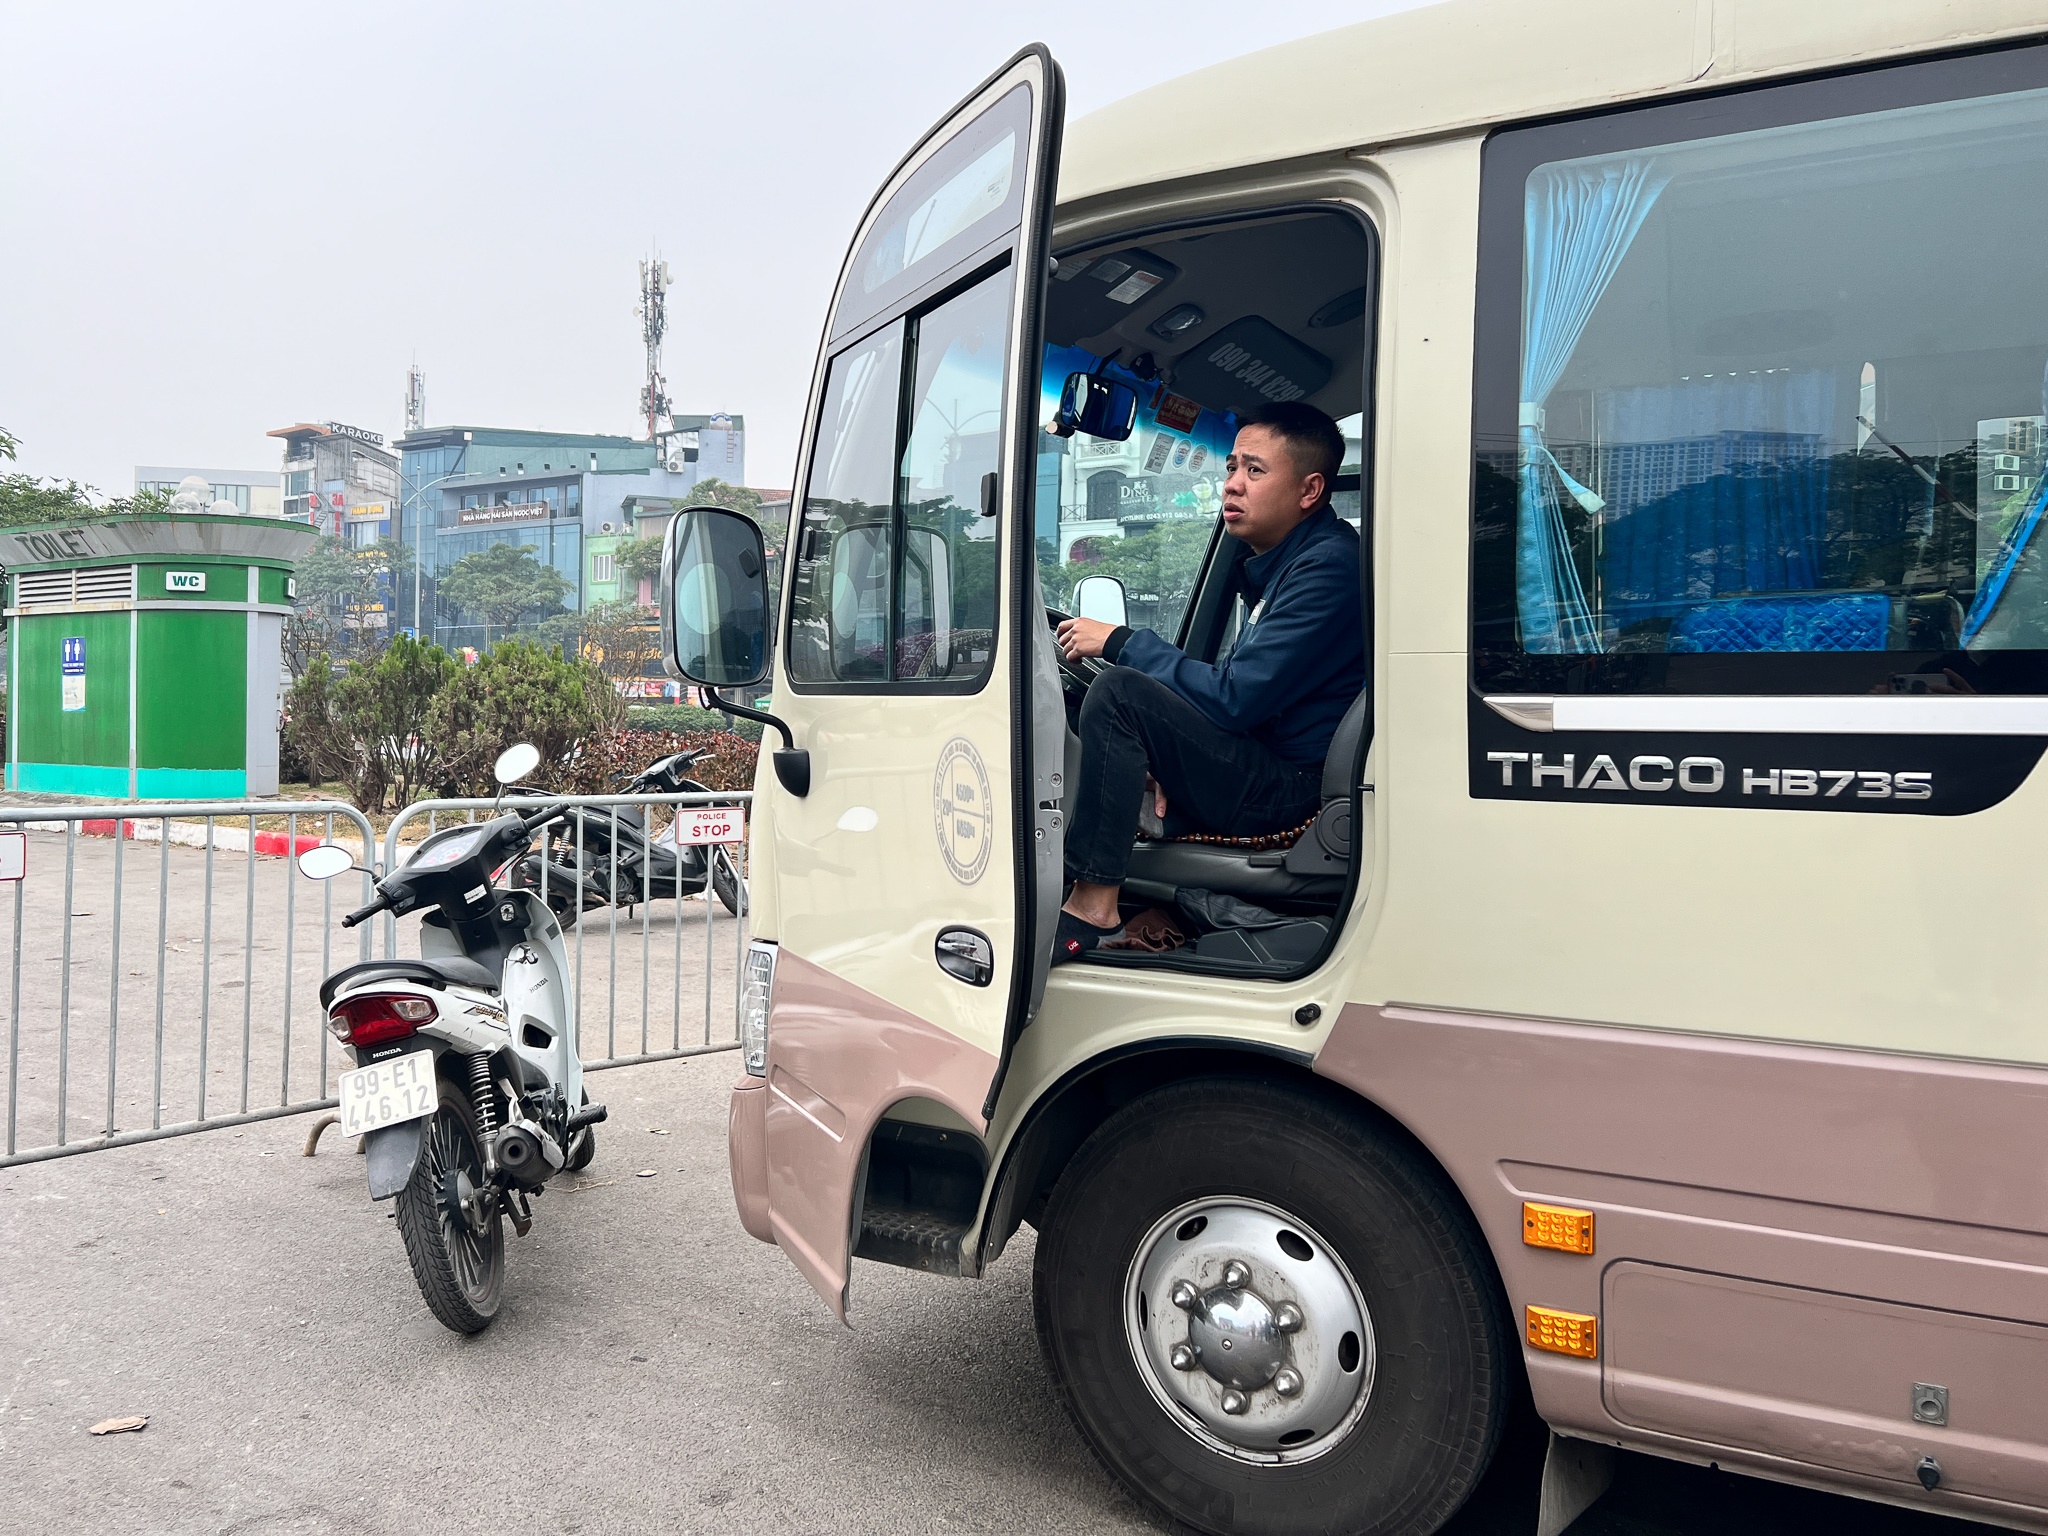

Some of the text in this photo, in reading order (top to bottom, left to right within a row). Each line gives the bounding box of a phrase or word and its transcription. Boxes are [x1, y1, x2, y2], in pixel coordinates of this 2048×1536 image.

[1208, 342, 1251, 372] 090
[1235, 359, 1276, 388] 344
[332, 423, 383, 443] KARAOKE
[463, 512, 475, 522] NHÀ
[475, 511, 491, 521] HÀNG
[529, 506, 544, 516] VIỆT
[14, 529, 96, 562] TOILET
[172, 575, 200, 587] WC
[1486, 751, 1933, 800] THACO HB73S
[697, 812, 727, 820] POLICE
[692, 824, 731, 837] STOP
[529, 977, 549, 994] HONDA
[372, 1047, 402, 1059] HONDA
[353, 1058, 417, 1099] 99-E1
[349, 1084, 430, 1130] 446.12
